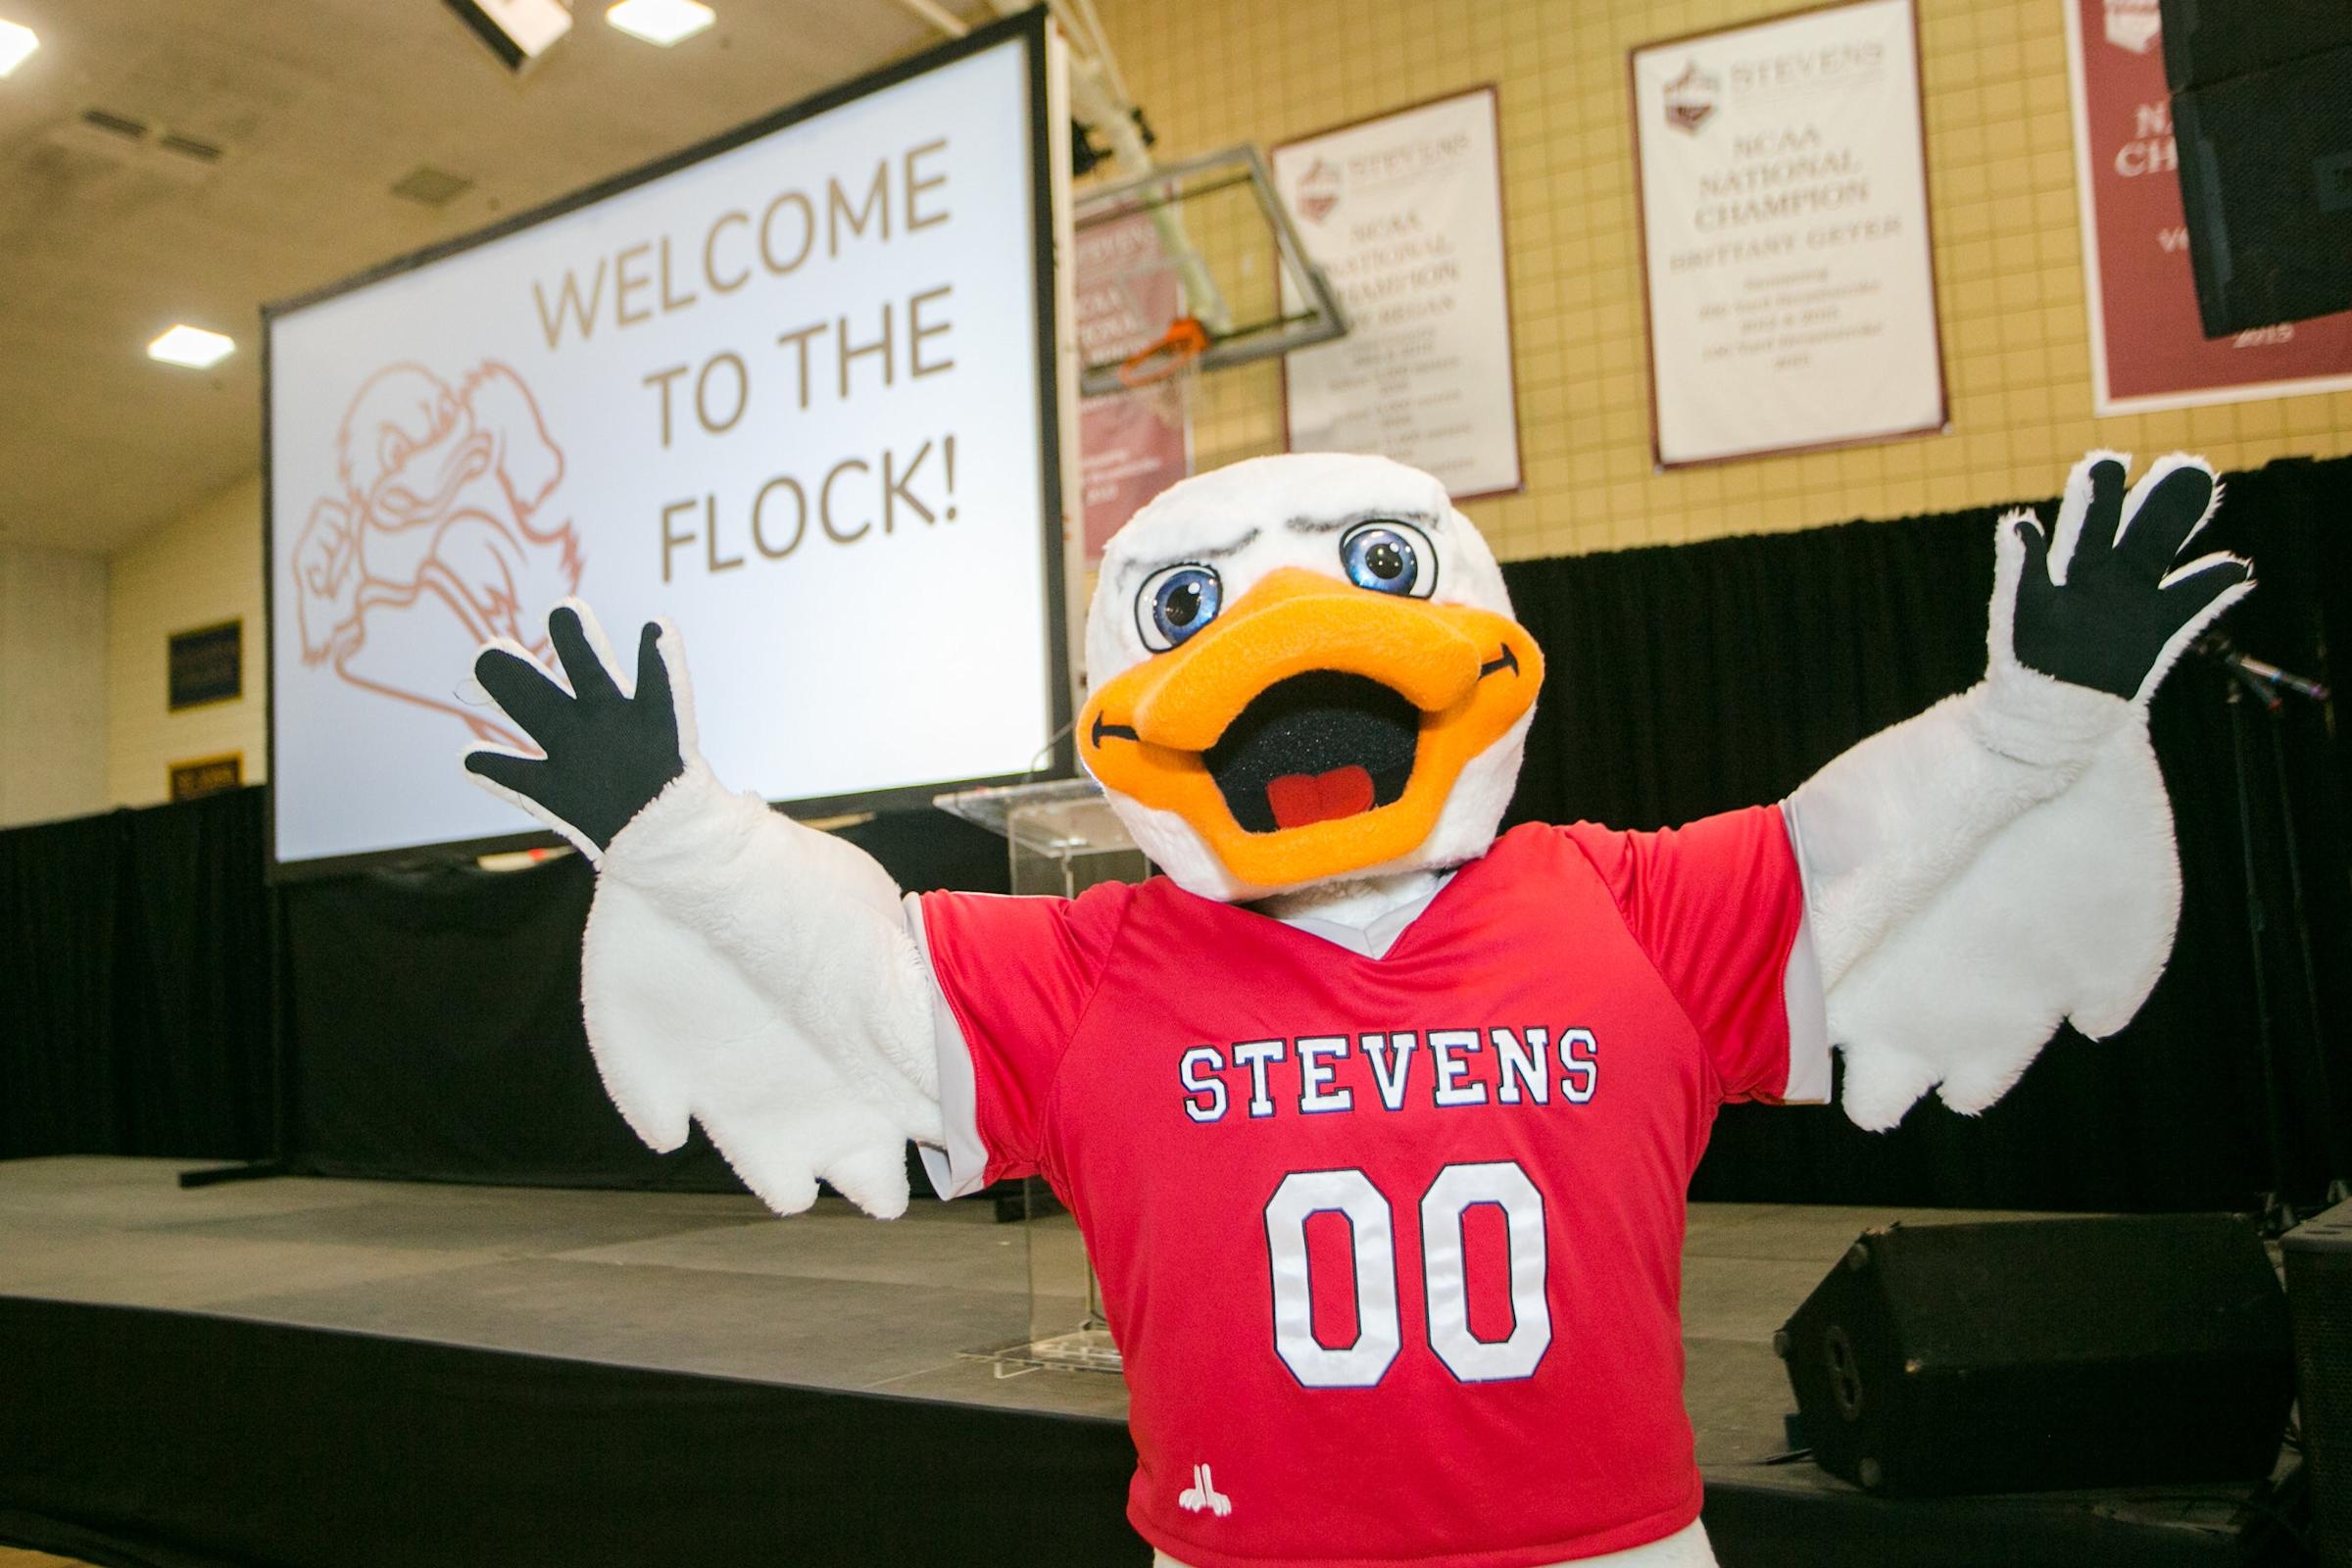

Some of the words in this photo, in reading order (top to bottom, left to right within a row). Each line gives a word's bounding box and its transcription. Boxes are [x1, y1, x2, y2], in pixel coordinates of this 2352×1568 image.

[1698, 149, 1861, 198] NATIONAL
[1733, 123, 1822, 160] NCAA
[534, 138, 950, 352] WELCOME
[1693, 180, 1870, 234] CHAMPION
[642, 352, 749, 450] TO
[778, 284, 956, 411] THE
[662, 434, 957, 584] FLOCK!
[1179, 1026, 1599, 1124] STEVENS
[1263, 1159, 1554, 1389] 00
